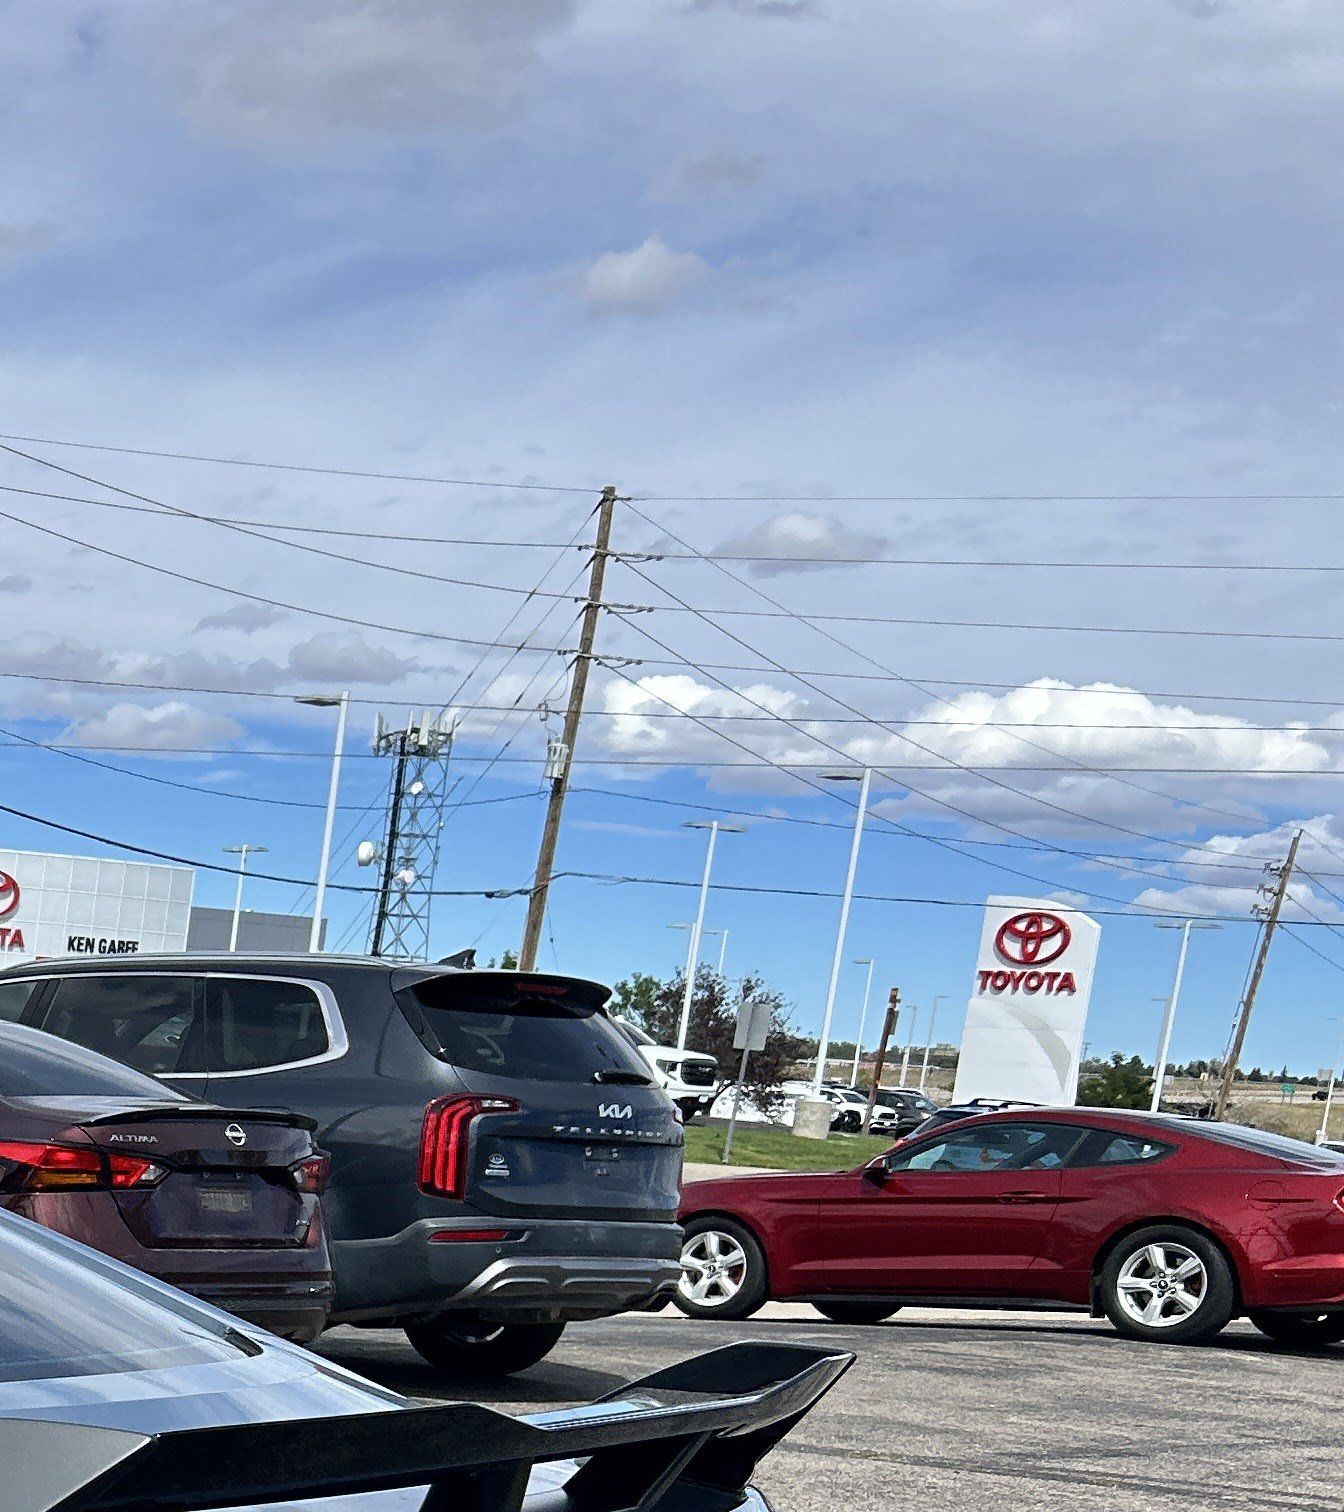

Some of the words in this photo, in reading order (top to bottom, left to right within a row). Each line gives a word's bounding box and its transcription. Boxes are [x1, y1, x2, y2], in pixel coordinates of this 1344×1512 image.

[68, 935, 95, 953] KEN
[98, 938, 140, 954] GARFF
[978, 970, 1077, 995] TOYOTA
[109, 1134, 159, 1143] ALTIMA
